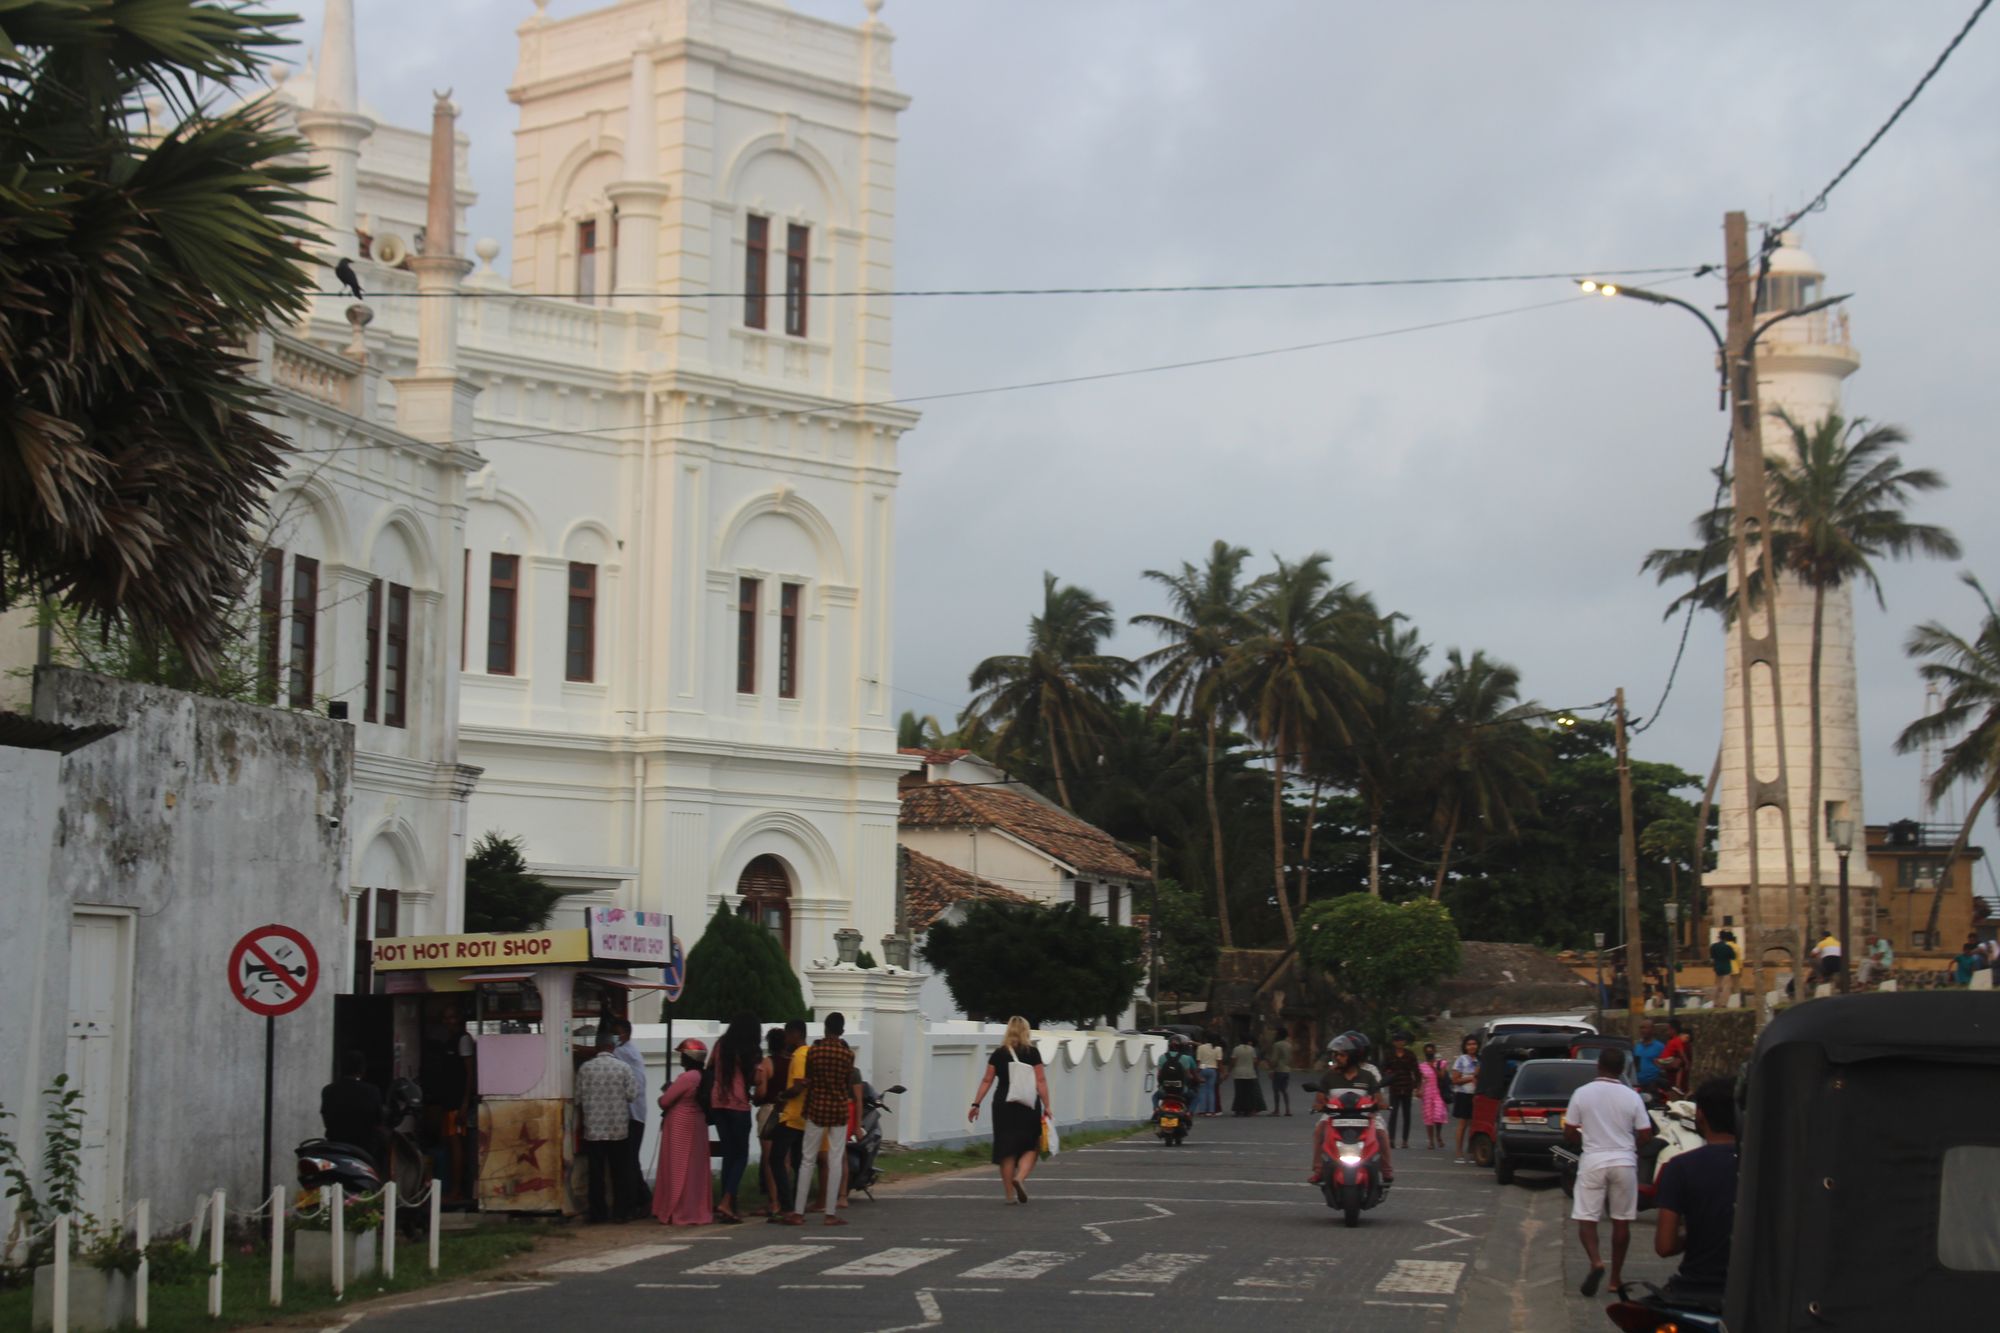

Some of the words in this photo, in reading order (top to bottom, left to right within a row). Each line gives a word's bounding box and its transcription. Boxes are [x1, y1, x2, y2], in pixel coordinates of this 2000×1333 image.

[374, 944, 407, 961] HOT
[413, 942, 450, 960] HOT
[456, 940, 497, 958] ROTI
[503, 938, 552, 956] SHOP
